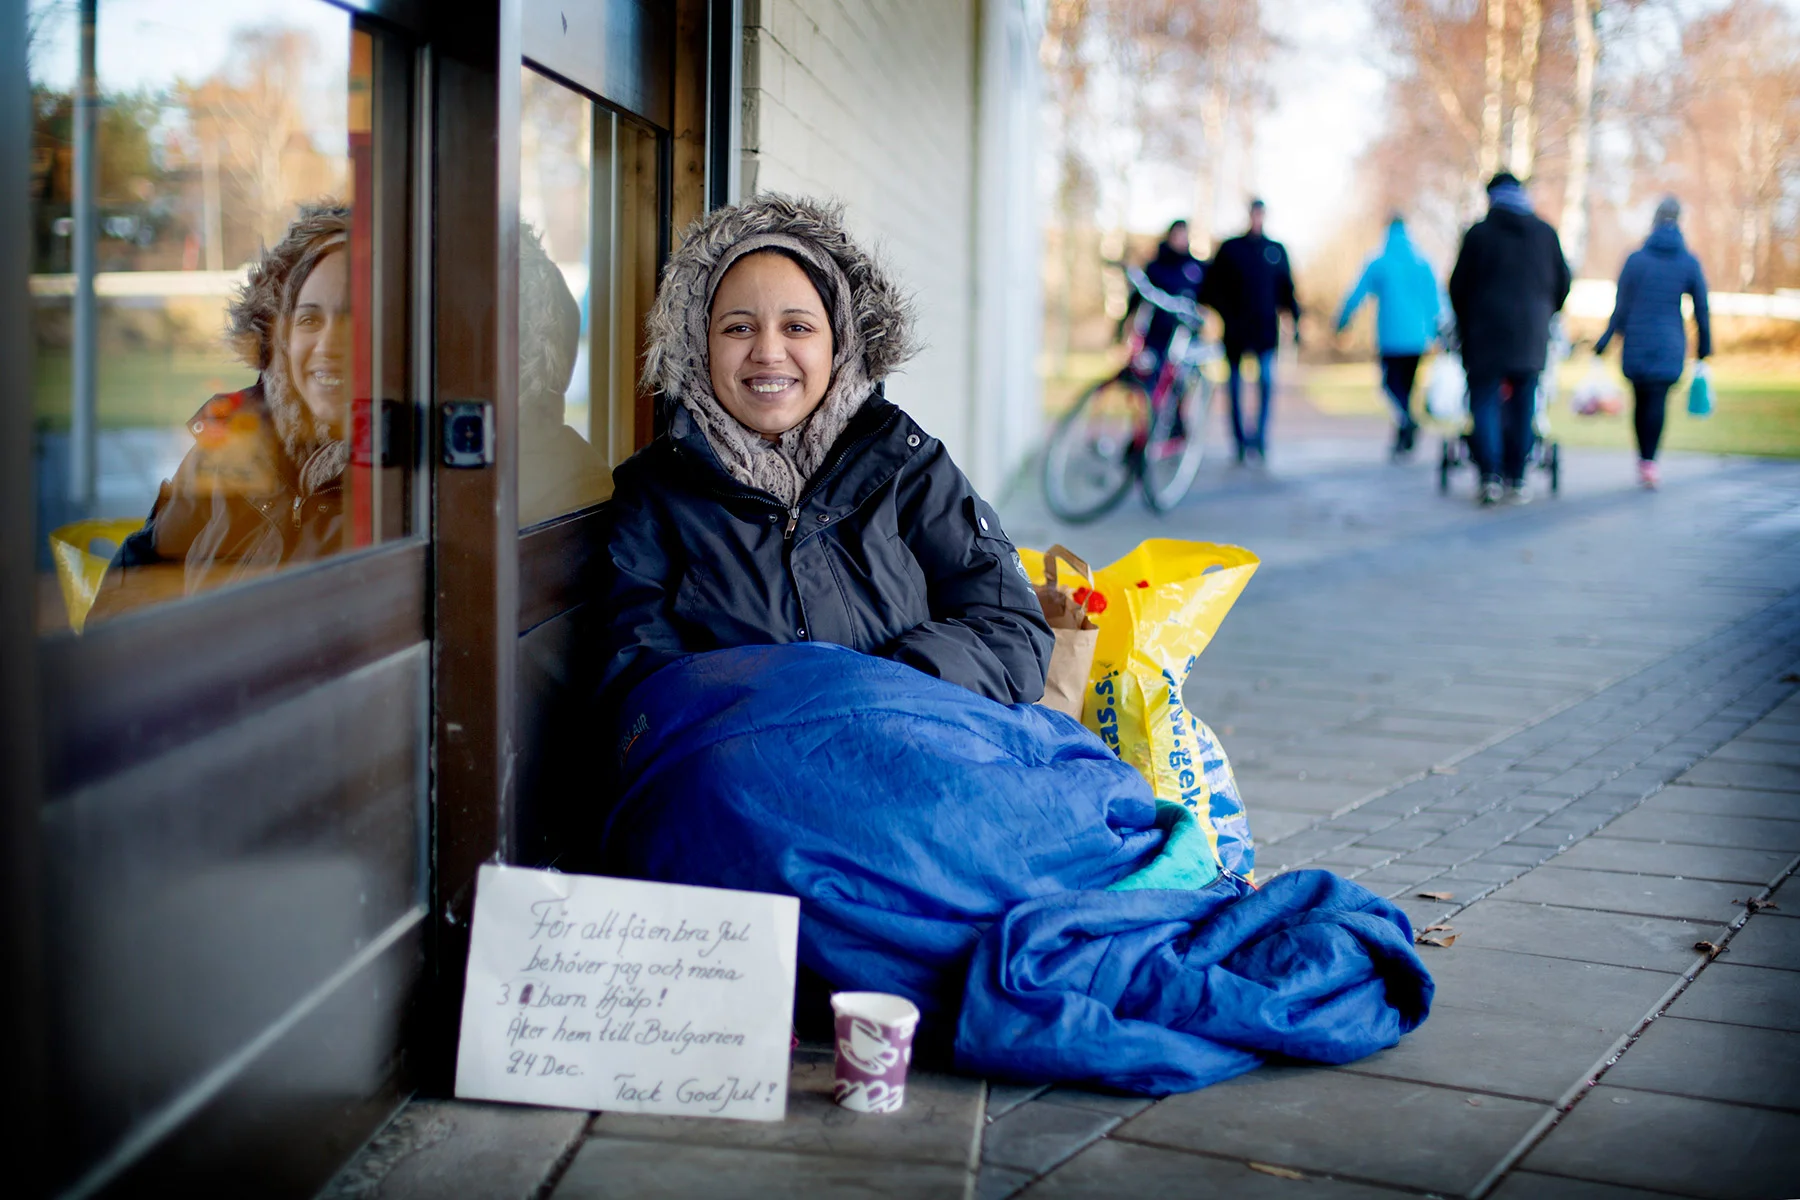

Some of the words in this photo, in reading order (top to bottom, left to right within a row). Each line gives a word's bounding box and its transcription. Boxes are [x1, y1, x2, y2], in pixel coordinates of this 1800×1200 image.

[529, 896, 577, 940] För
[671, 918, 710, 943] bra
[604, 954, 643, 986] jag
[648, 958, 684, 980] och
[688, 960, 744, 981] mina
[496, 983, 511, 1006] 3
[531, 984, 588, 1008] barn
[507, 1010, 549, 1047] Åker
[552, 1015, 591, 1043] hem
[599, 1017, 636, 1042] till
[634, 1018, 746, 1055] Bulgarien
[506, 1050, 538, 1077] 24
[613, 1072, 664, 1101] Tack
[676, 1078, 726, 1105] God
